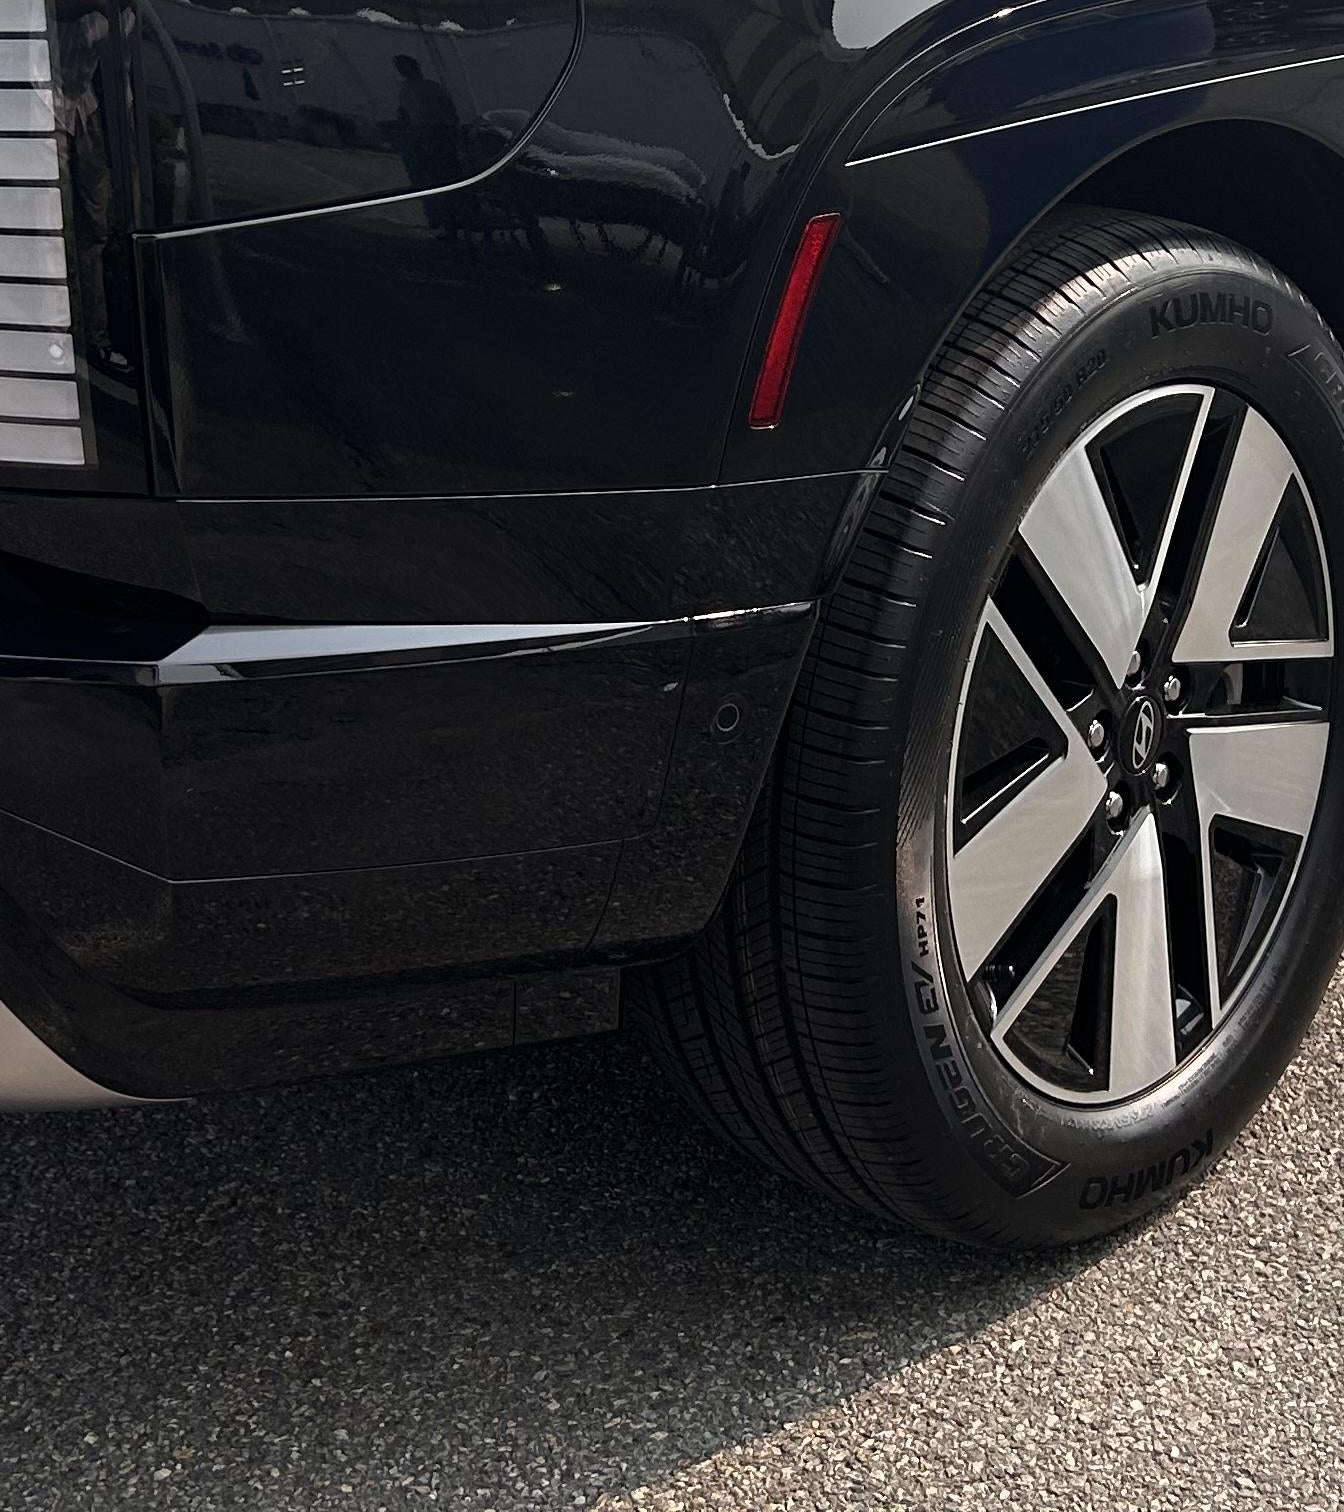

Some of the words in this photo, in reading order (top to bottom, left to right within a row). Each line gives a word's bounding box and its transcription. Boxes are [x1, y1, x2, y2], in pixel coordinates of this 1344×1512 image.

[1148, 291, 1274, 339] KUMHO
[915, 896, 929, 957] HP71
[1077, 1128, 1215, 1209] KUMHO
